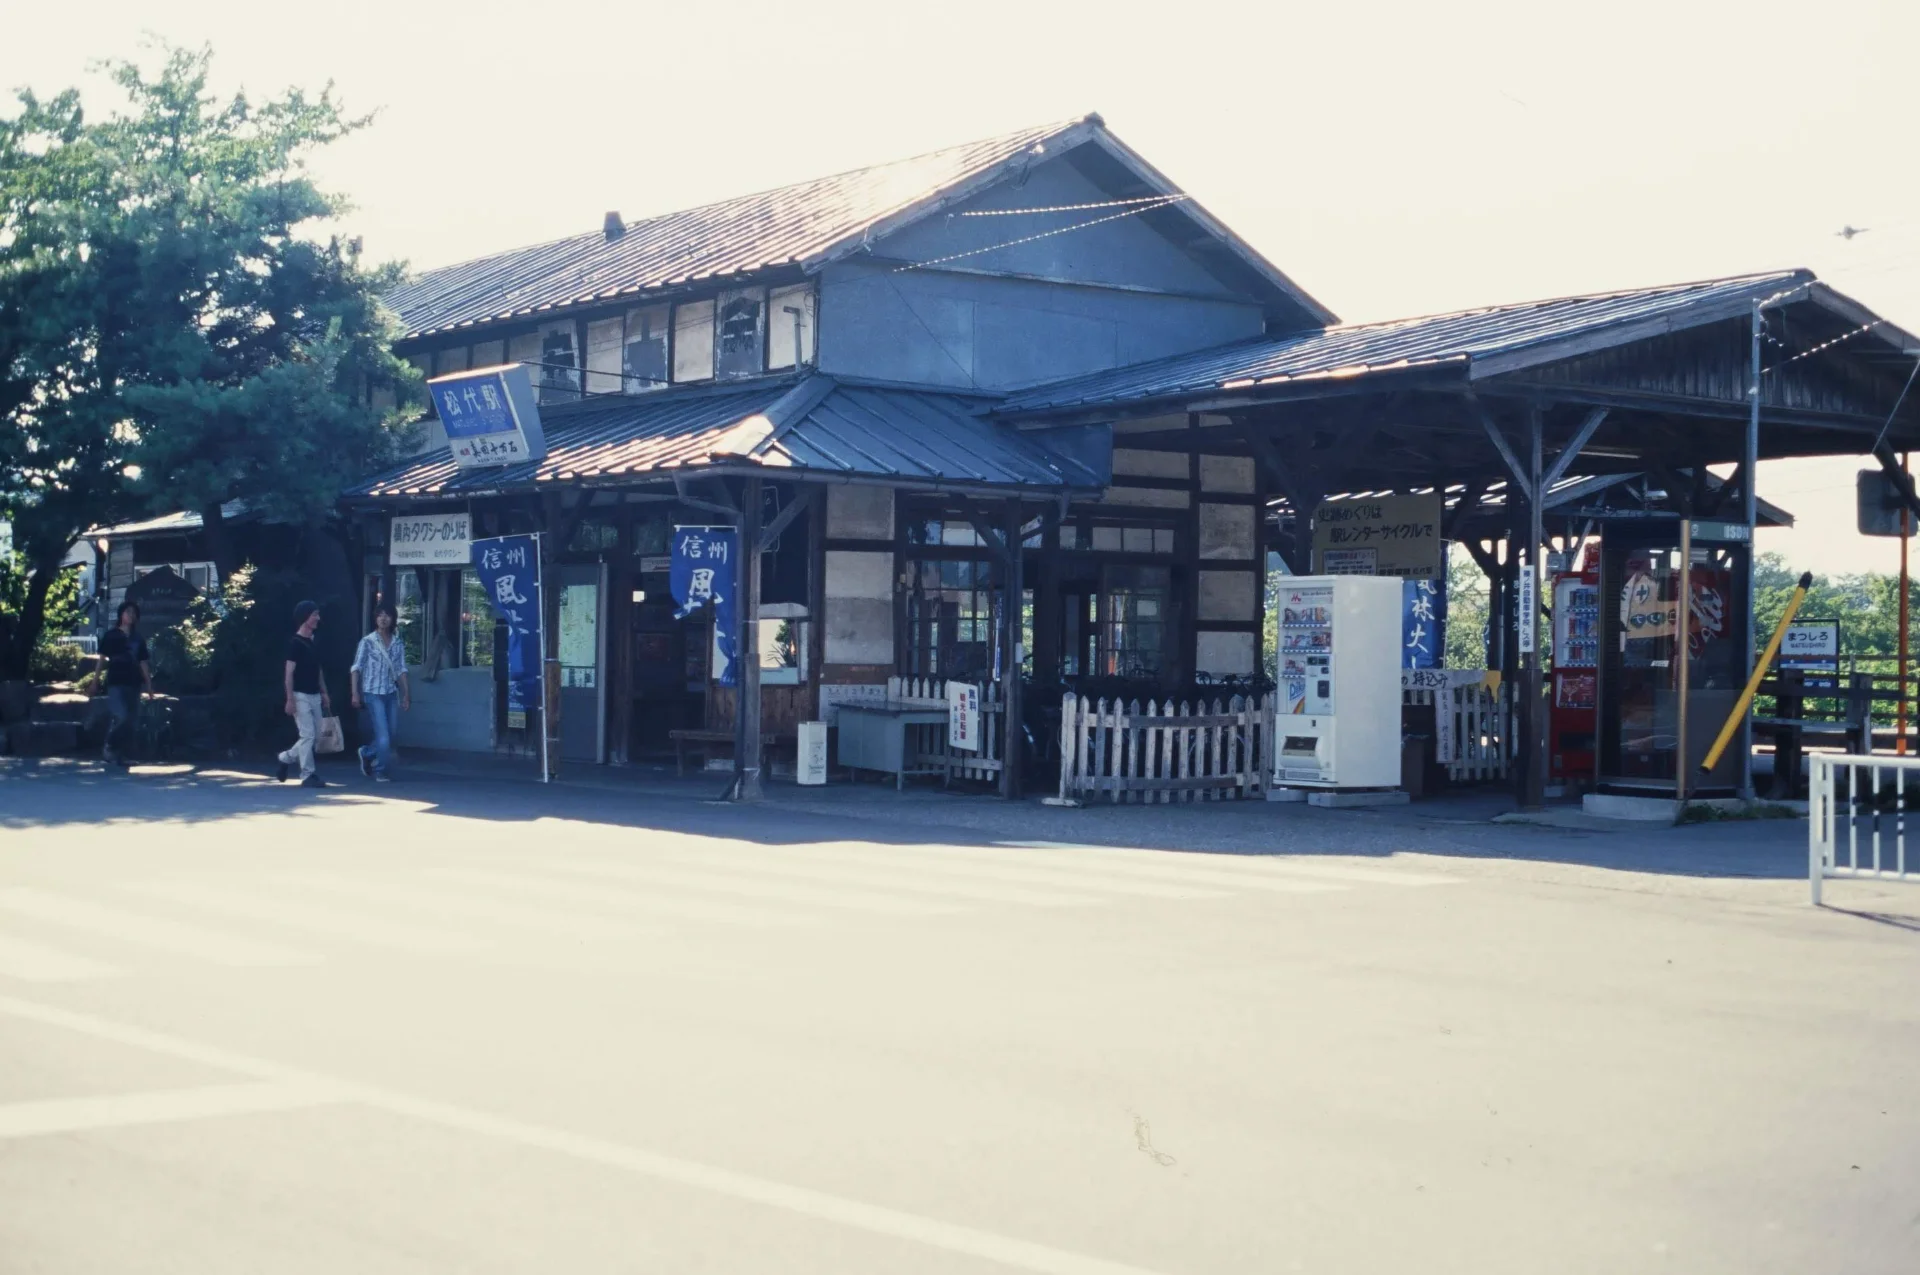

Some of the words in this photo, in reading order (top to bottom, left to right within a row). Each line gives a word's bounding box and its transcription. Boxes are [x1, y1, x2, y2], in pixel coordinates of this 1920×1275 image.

[443, 384, 502, 416] 松代駅
[482, 546, 526, 570] 信州
[680, 535, 728, 565] 信州
[1788, 631, 1829, 641] まつしろ
